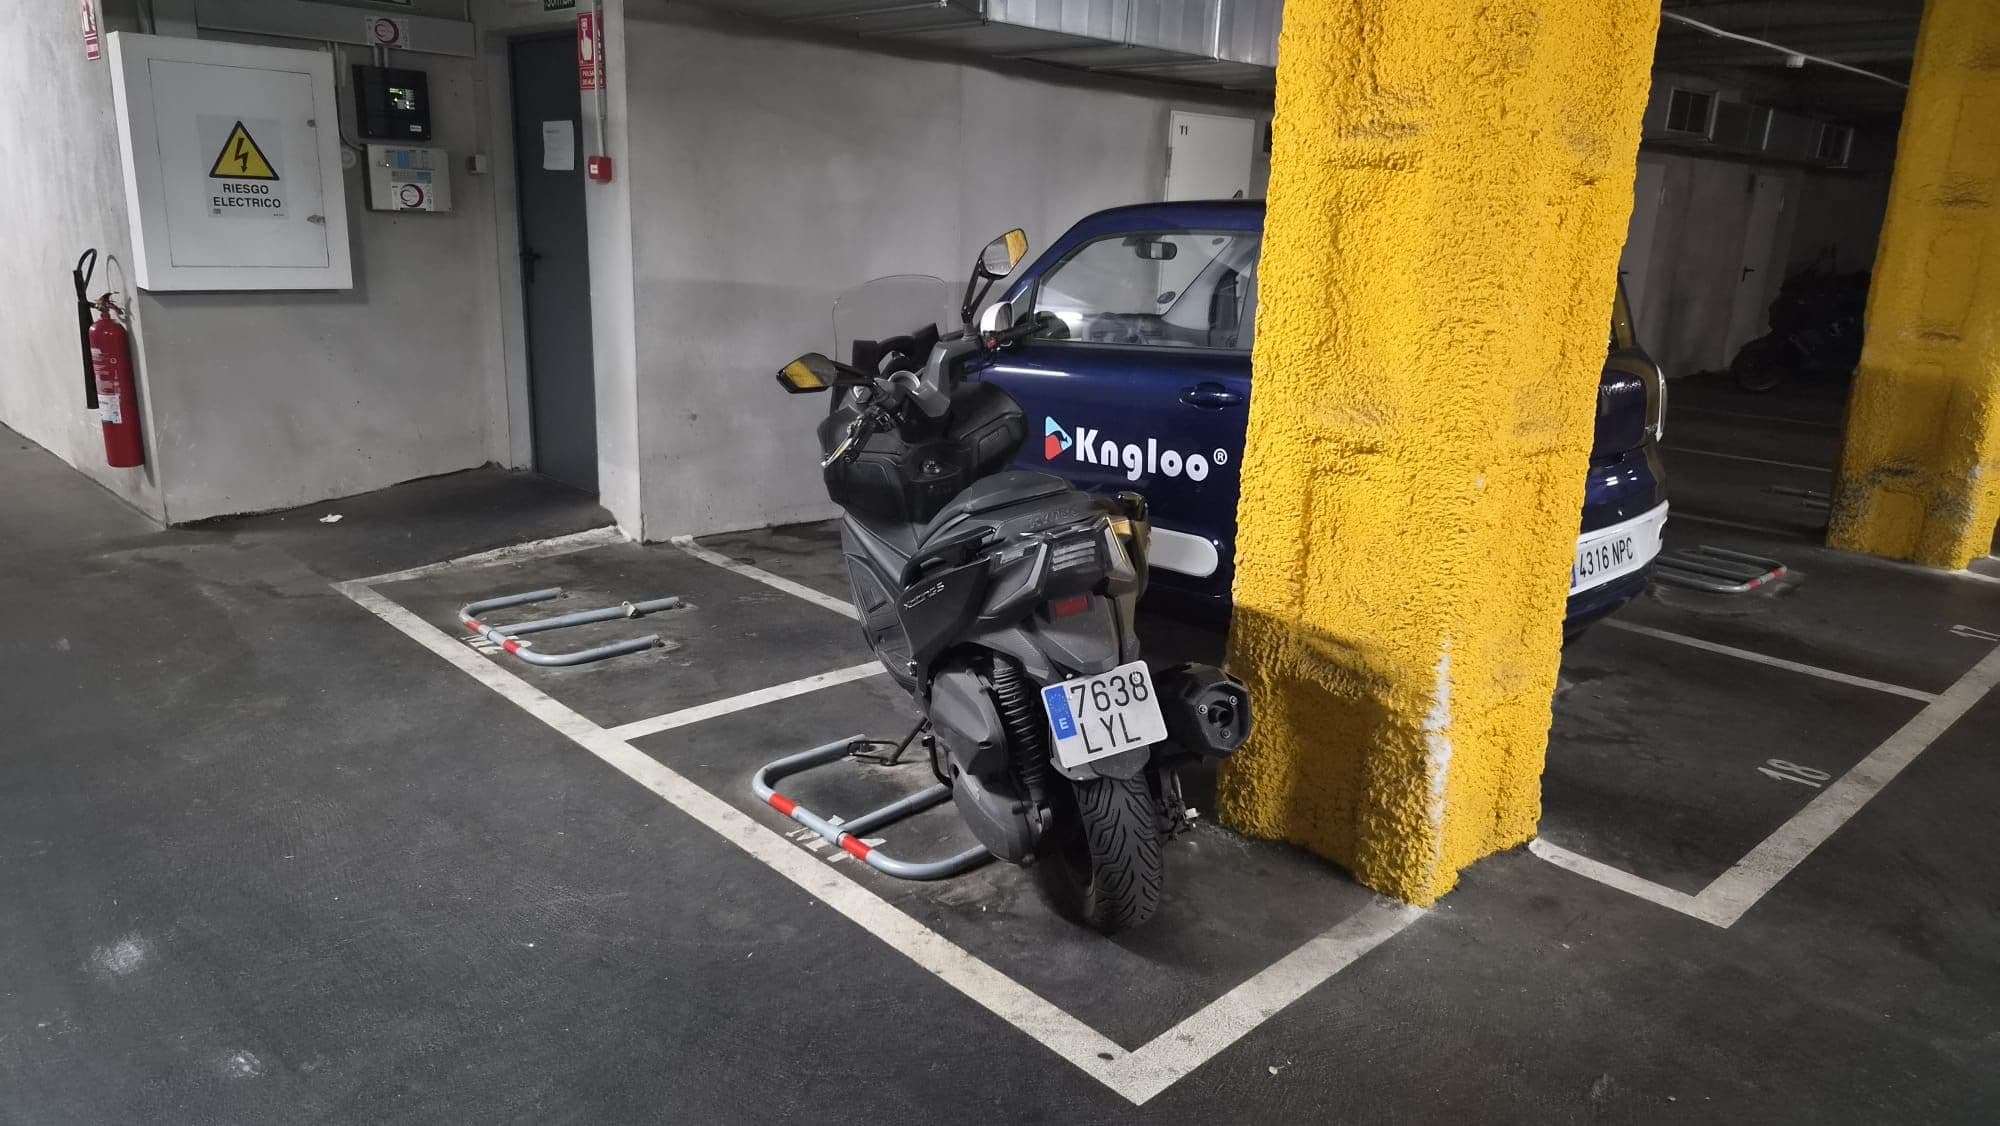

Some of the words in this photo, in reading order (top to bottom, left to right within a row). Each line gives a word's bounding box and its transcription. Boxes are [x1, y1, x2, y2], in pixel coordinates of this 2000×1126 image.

[213, 196, 281, 209] ELECTRICO
[223, 183, 269, 195] RIESGO
[1580, 546, 1609, 578] 4316
[1612, 537, 1633, 566] NPC
[1070, 671, 1148, 718] 7638
[1058, 717, 1070, 731] E
[1080, 712, 1141, 754] LYL
[1757, 758, 1831, 788] 18
